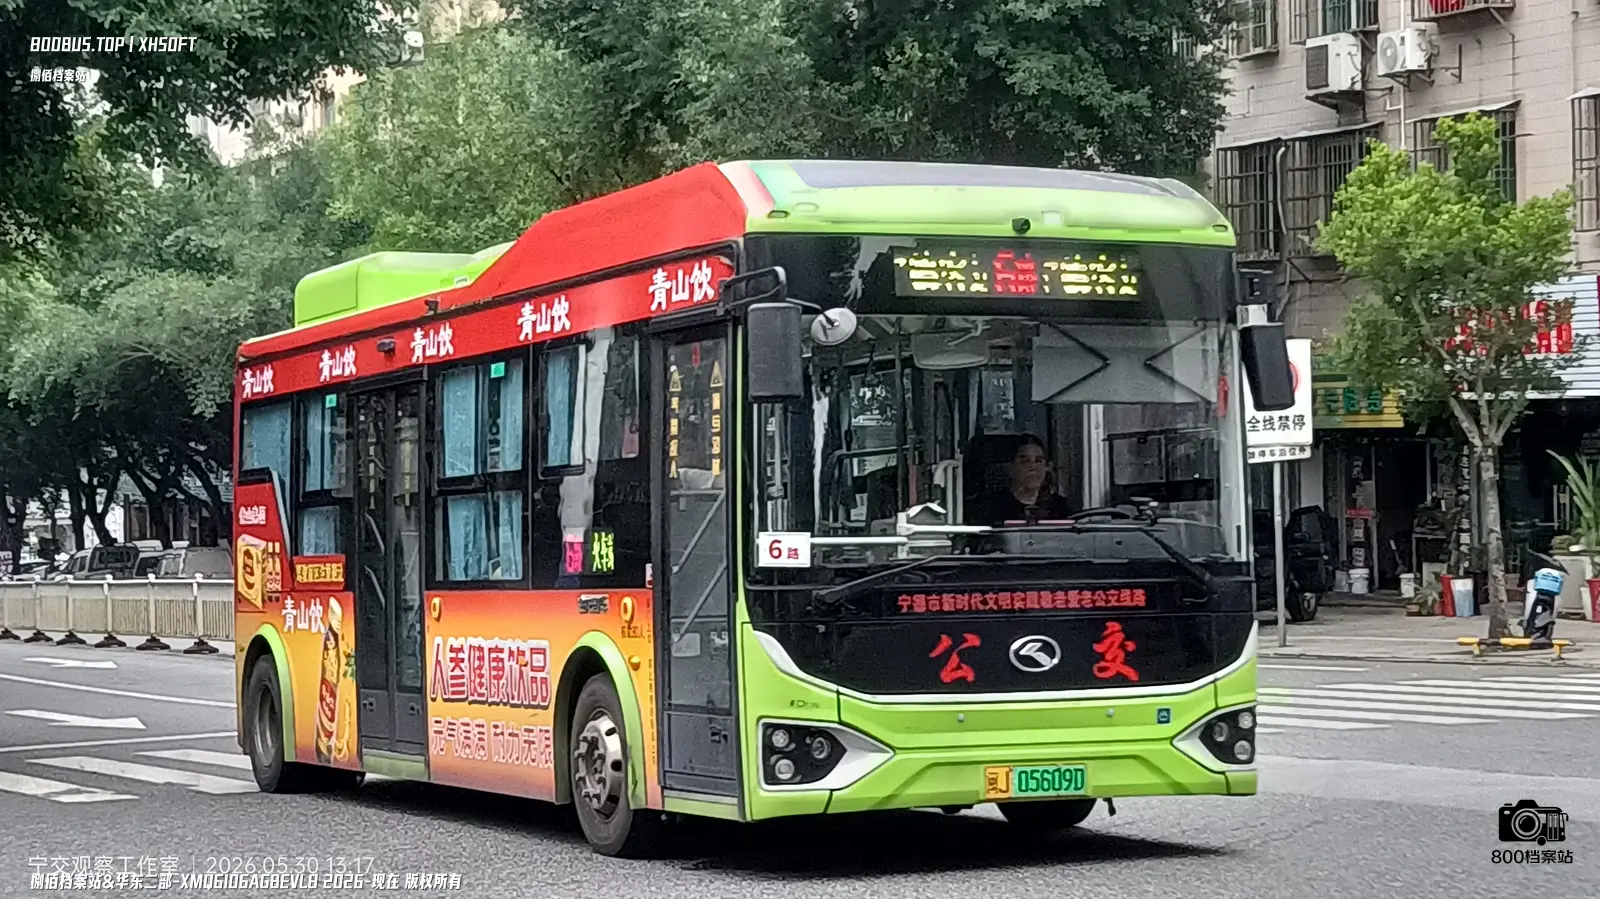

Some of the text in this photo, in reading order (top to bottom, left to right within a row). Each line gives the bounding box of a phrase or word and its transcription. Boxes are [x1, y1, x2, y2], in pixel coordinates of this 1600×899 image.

[648, 260, 716, 311] 青山饮
[517, 294, 571, 342] 青山饮
[319, 345, 357, 382] 青山饮
[410, 322, 454, 363] 青山饮
[241, 364, 274, 399] 青山饮
[1246, 414, 1306, 432] 全线禁停
[281, 595, 327, 634] 青山饮
[430, 637, 551, 709] 人参健康饮品
[930, 622, 1138, 683] 公 交
[431, 716, 554, 770] 元气满满 耐力无限
